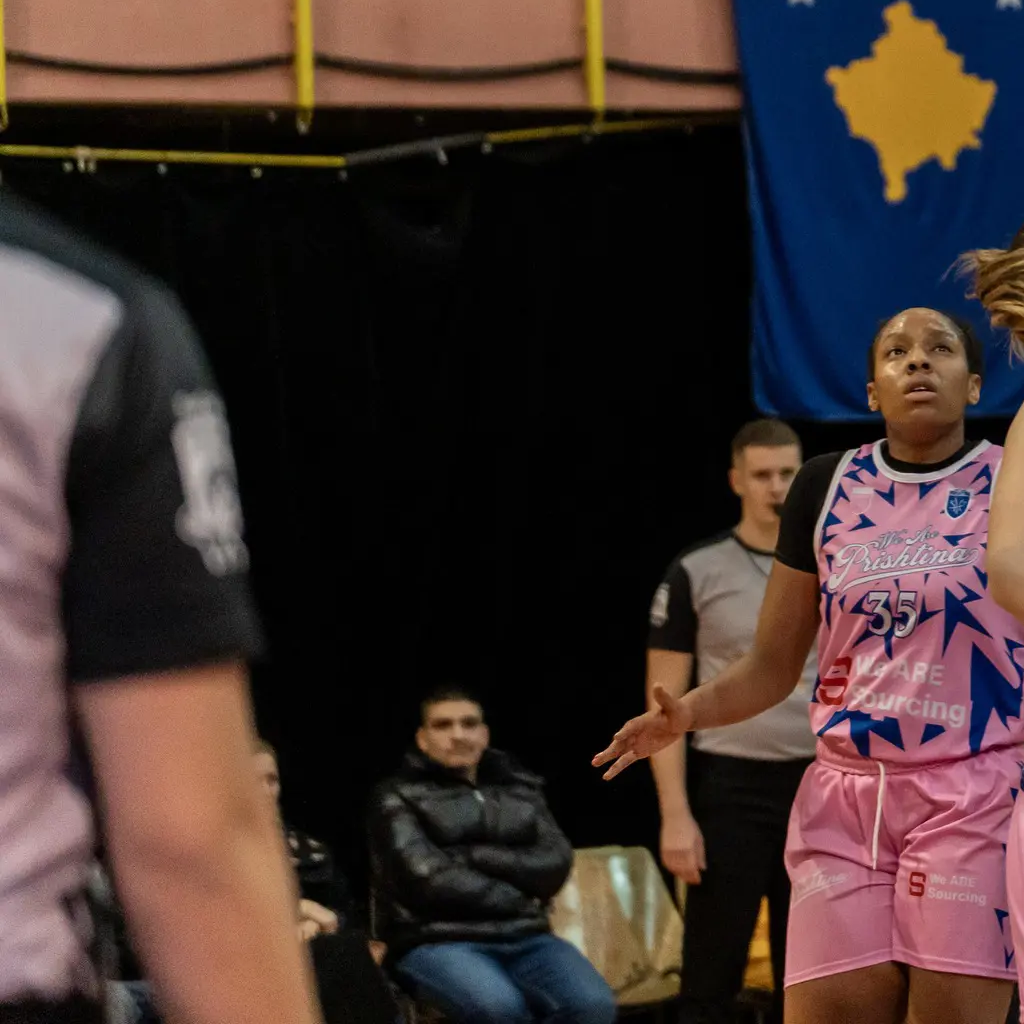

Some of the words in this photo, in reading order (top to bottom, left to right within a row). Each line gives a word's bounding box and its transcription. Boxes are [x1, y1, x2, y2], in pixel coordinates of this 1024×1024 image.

[827, 542, 979, 593] Prishtina
[867, 591, 918, 638] 35
[856, 655, 887, 677] We
[894, 659, 946, 686] ARE
[850, 685, 966, 728] Sourcing
[927, 887, 987, 906] Sourcing
[929, 873, 946, 886] We
